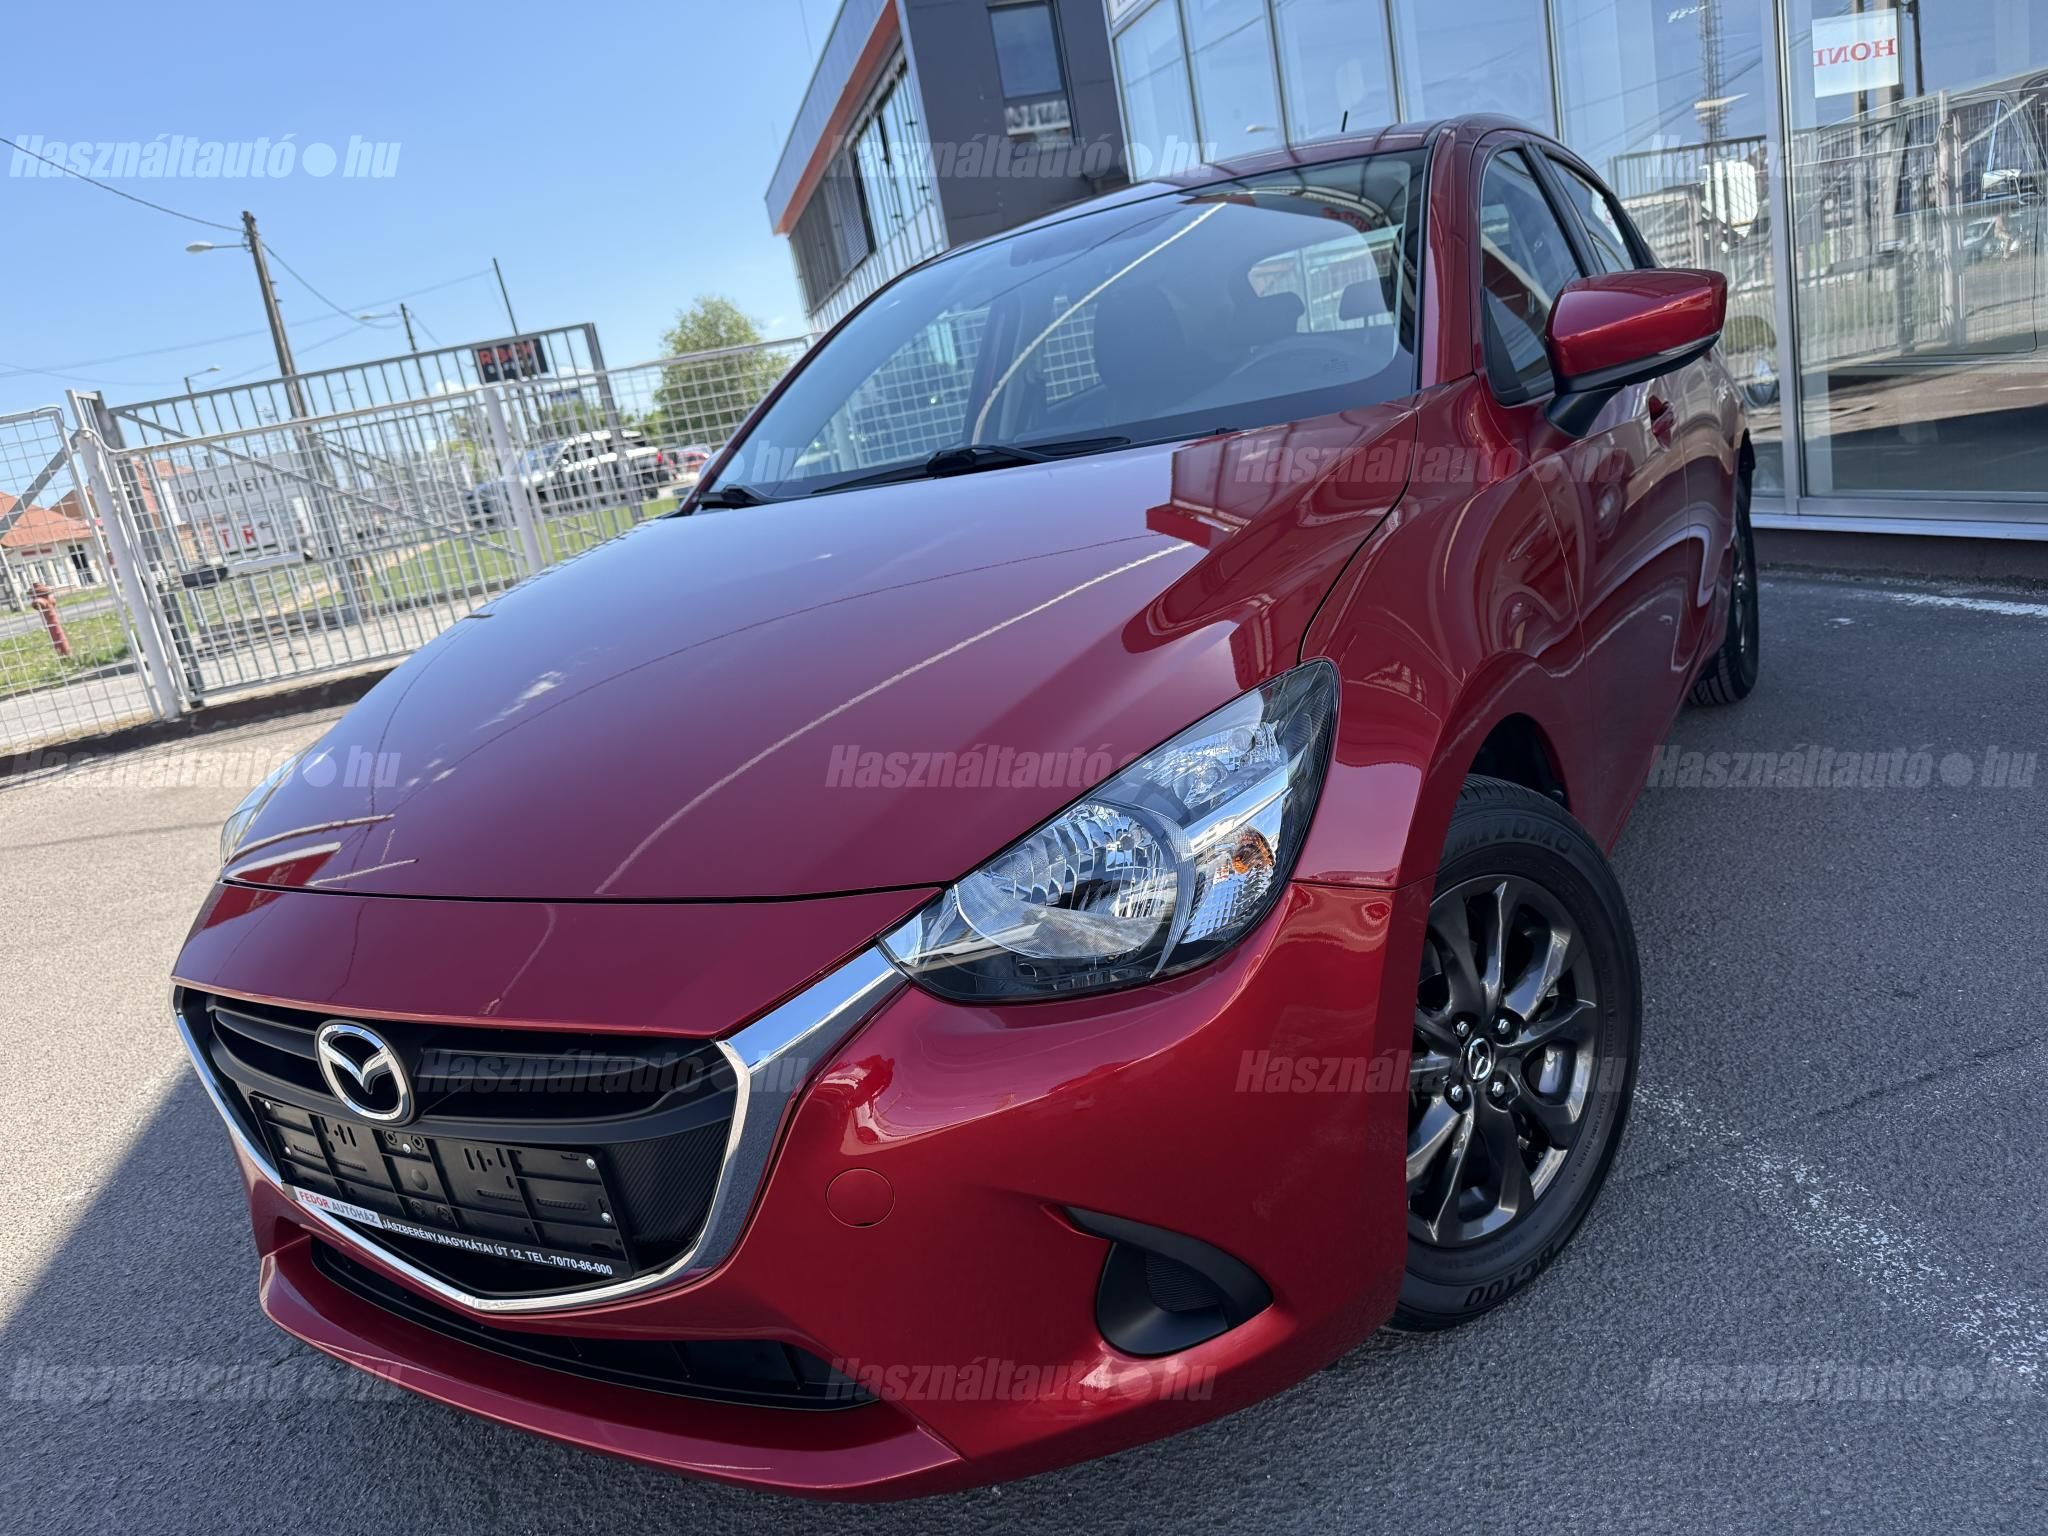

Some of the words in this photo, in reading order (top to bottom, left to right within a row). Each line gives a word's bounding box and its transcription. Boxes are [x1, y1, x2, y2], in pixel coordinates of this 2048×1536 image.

[299, 1191, 330, 1210] FEDOR
[332, 1200, 379, 1225] AUTÓHÁZ
[494, 1244, 509, 1257] ÚT
[510, 1249, 526, 1260] 12.
